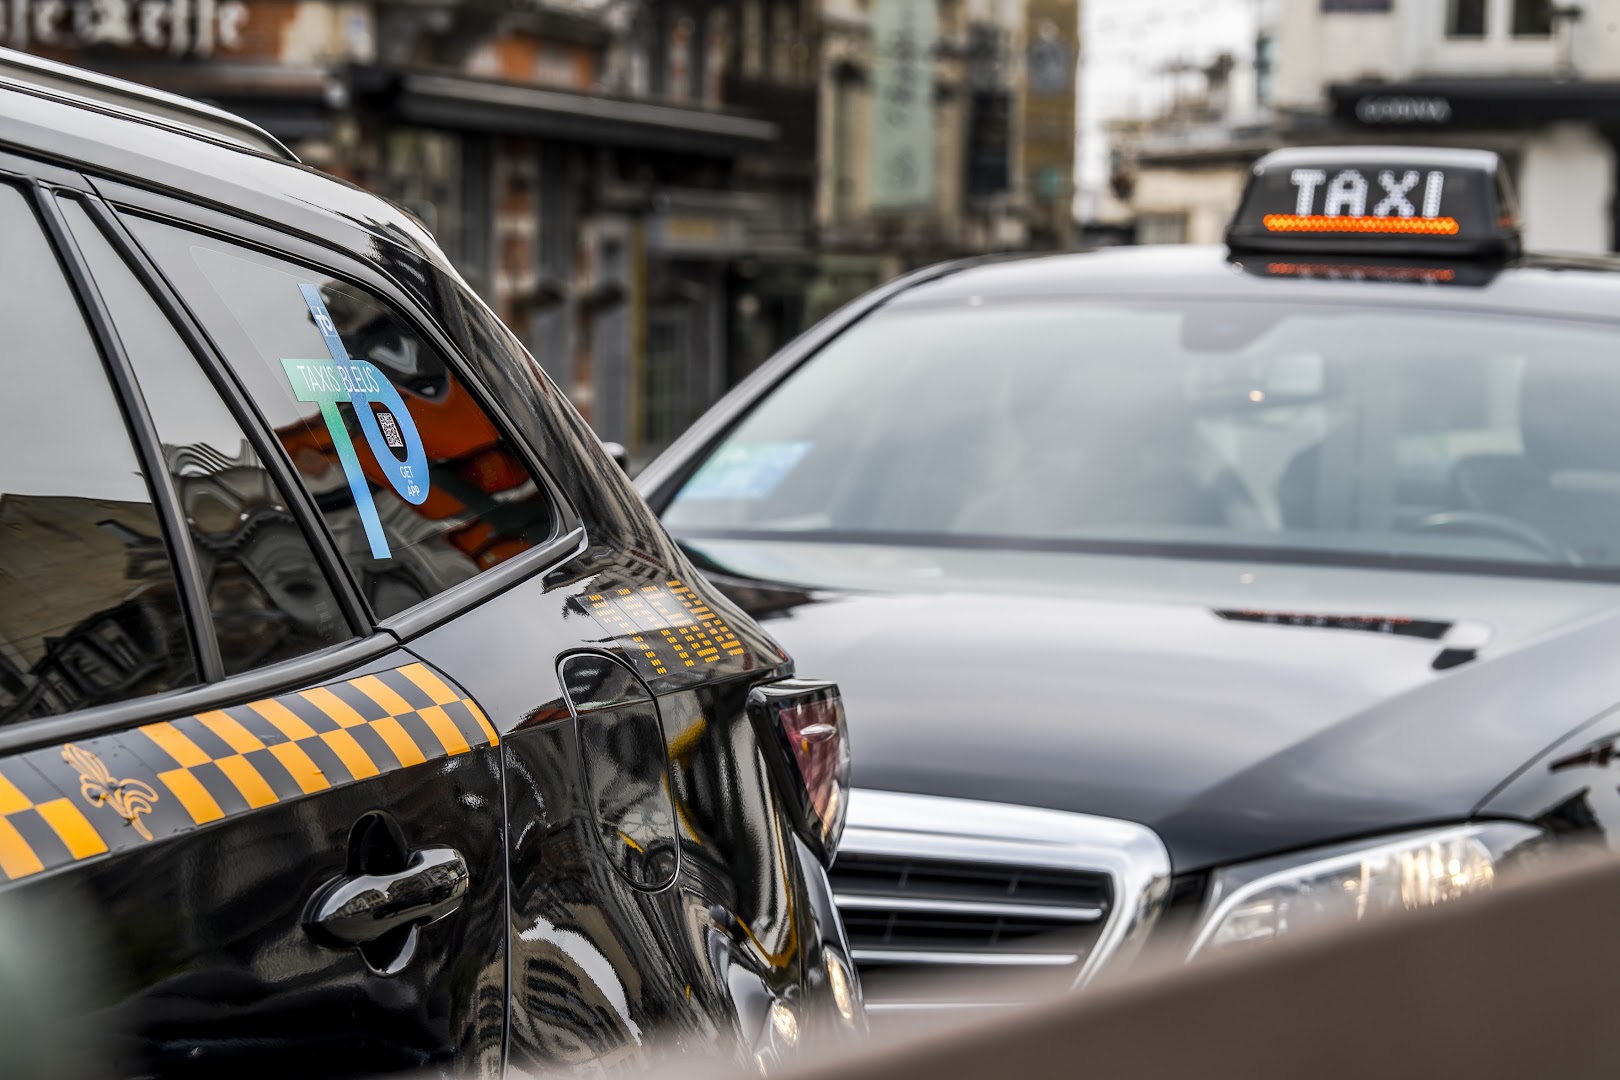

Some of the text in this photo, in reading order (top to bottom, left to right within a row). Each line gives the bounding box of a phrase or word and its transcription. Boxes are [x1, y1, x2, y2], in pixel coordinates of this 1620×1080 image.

[1290, 169, 1444, 218] TAXI
[296, 365, 380, 393] TAXIS BLEUS
[400, 465, 413, 478] GET
[407, 485, 420, 497] APP
